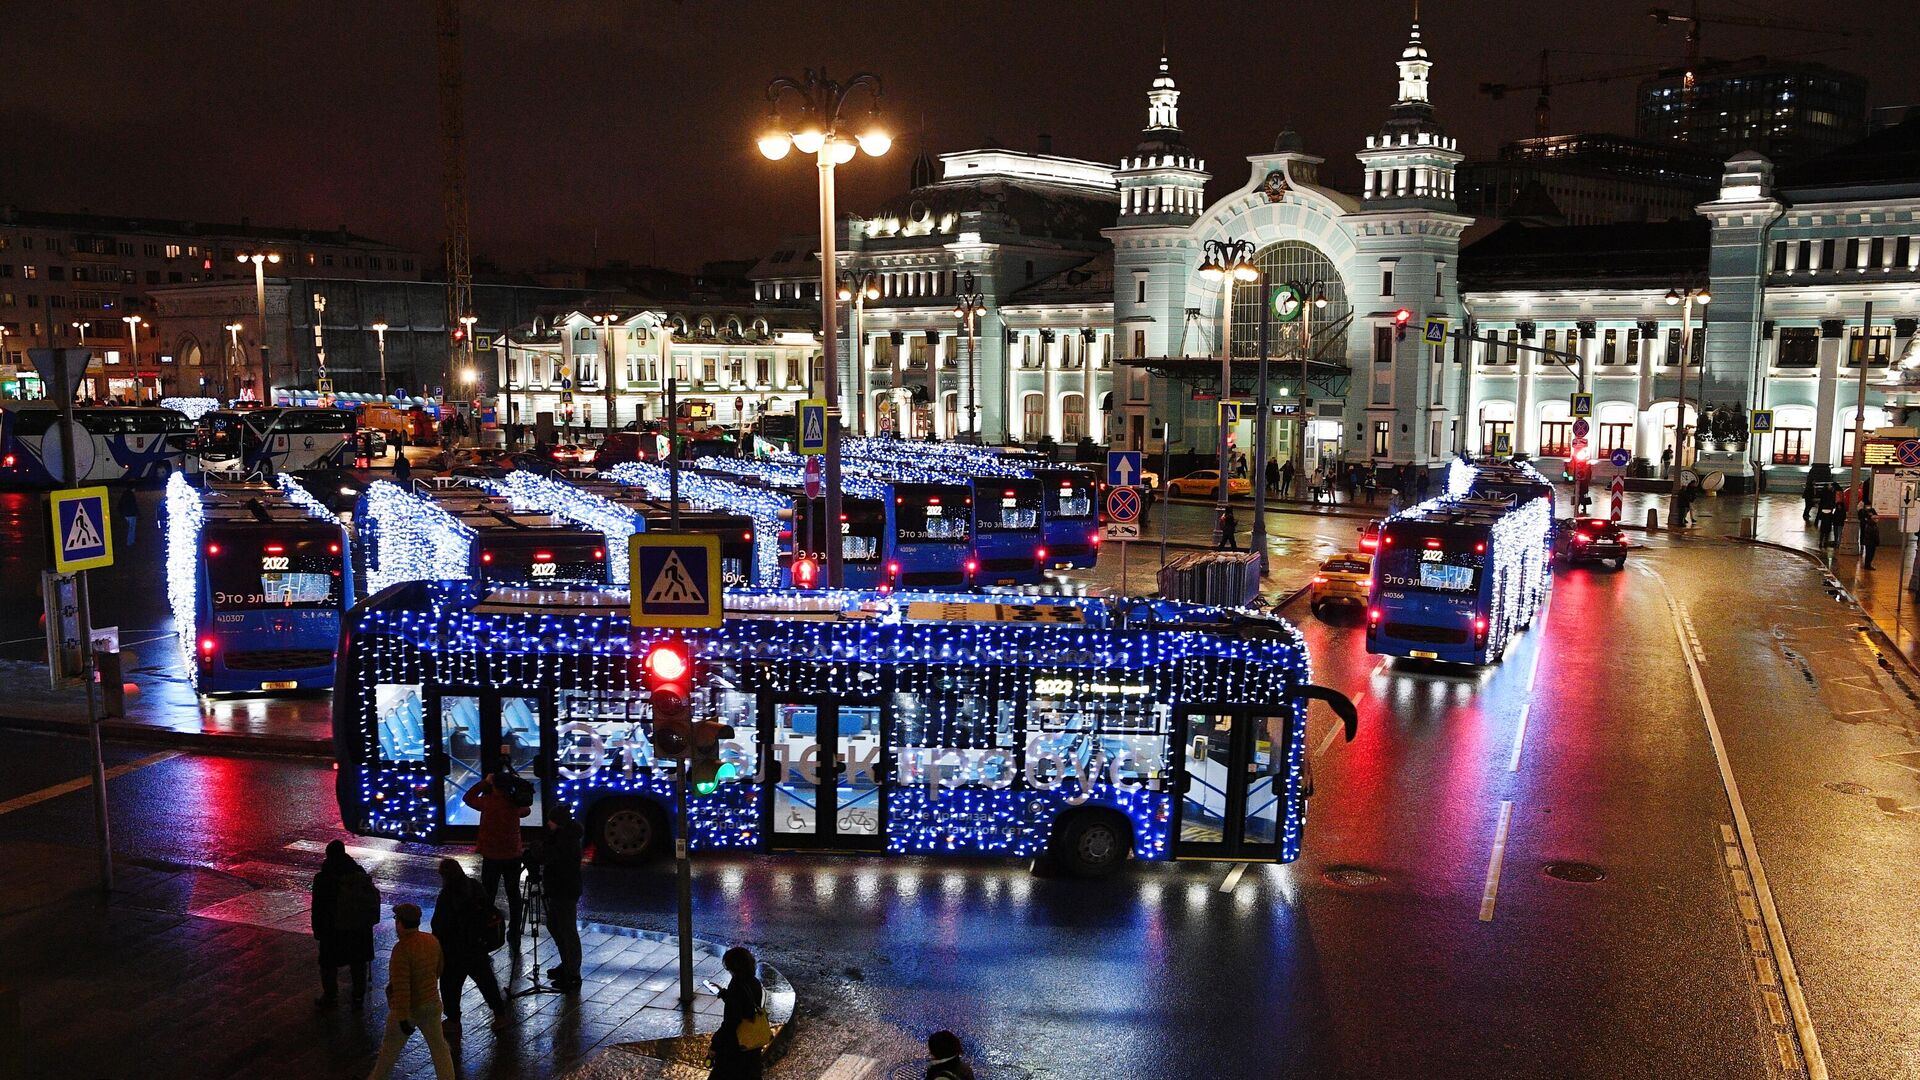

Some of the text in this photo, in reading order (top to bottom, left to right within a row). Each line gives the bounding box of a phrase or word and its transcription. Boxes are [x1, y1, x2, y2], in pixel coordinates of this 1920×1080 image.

[435, 387, 442, 395] P
[927, 506, 943, 516] 2022
[977, 519, 992, 528] Это
[899, 529, 916, 538] Это
[1422, 549, 1443, 561] 2022
[262, 557, 289, 570] 2022
[531, 563, 557, 576] 2022
[1383, 573, 1477, 592] Это элеробус.
[215, 591, 244, 604] Это
[1383, 591, 1405, 600] 410366
[217, 614, 245, 623] 410307
[1034, 679, 1073, 694] 2022
[911, 811, 996, 822] Не привязан
[923, 825, 999, 835] контактной
